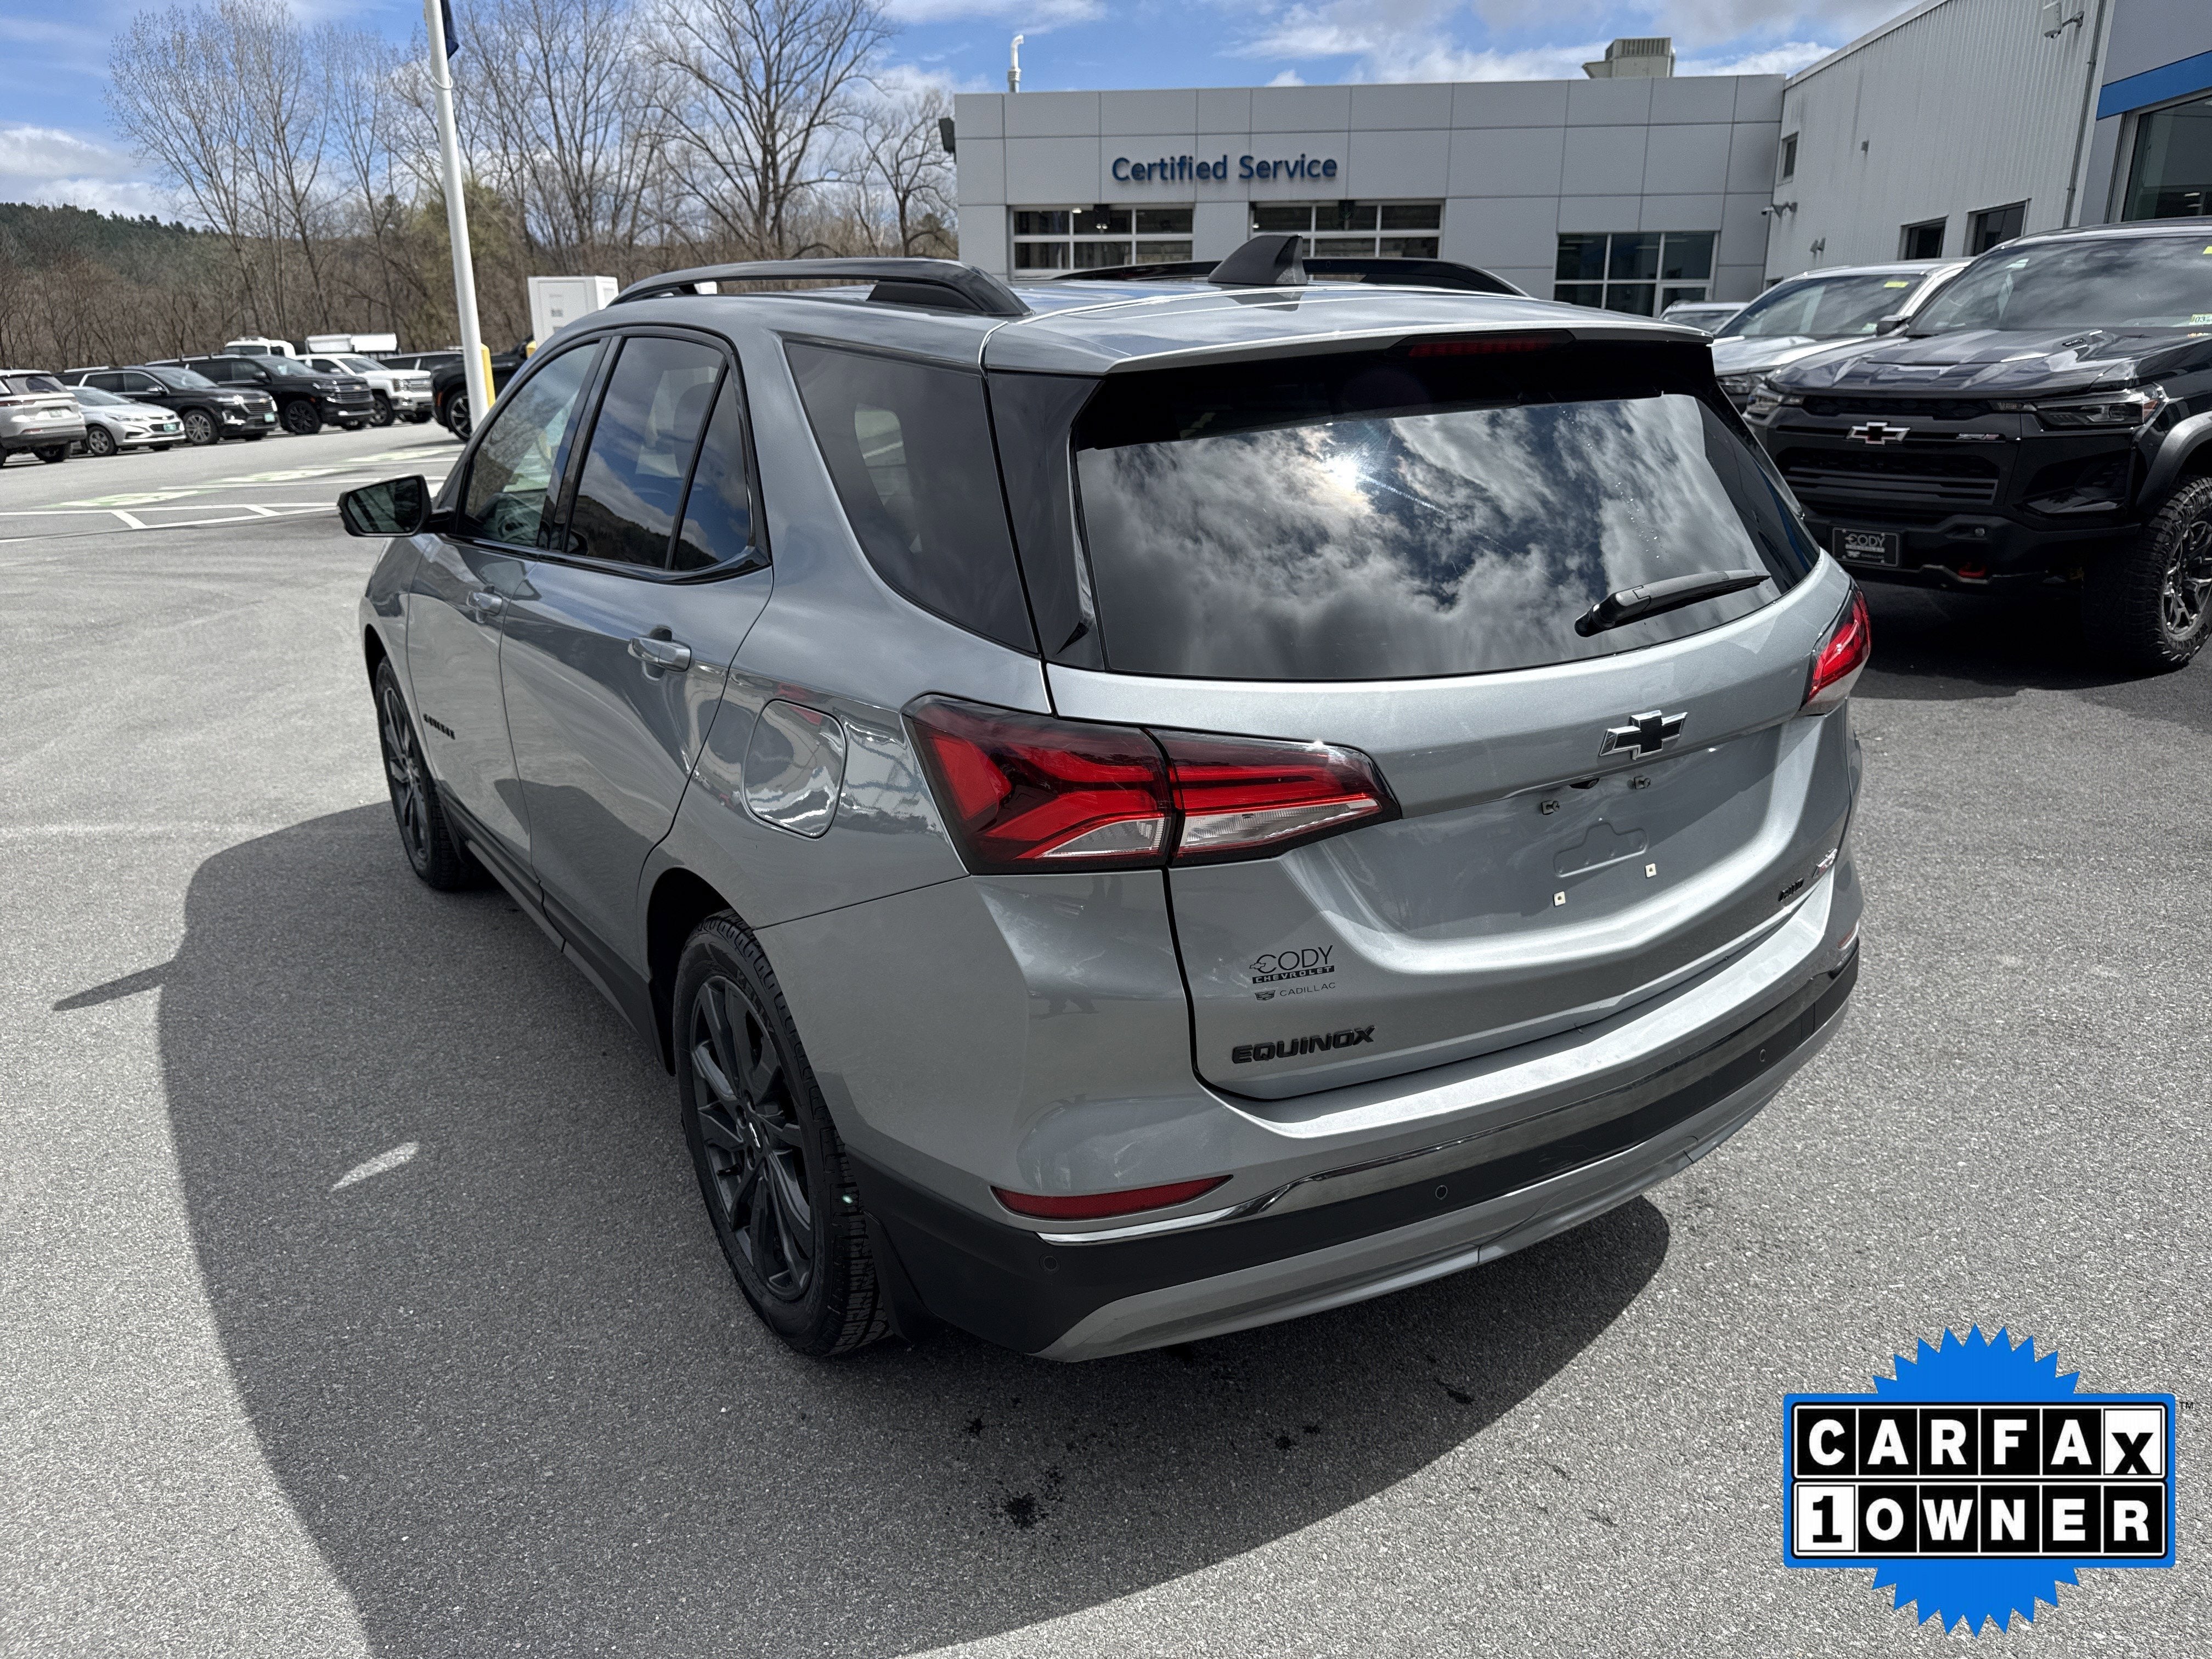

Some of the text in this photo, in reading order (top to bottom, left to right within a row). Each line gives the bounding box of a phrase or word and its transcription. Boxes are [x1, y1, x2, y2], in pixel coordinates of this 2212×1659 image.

[1112, 153, 1338, 181] Certified Service
[1848, 533, 1886, 548] CODY
[1255, 945, 1334, 974] CODY
[1254, 966, 1333, 984] CHEVROLET
[1279, 982, 1336, 997] CADILLAC
[1232, 1025, 1375, 1064] EQUINOX
